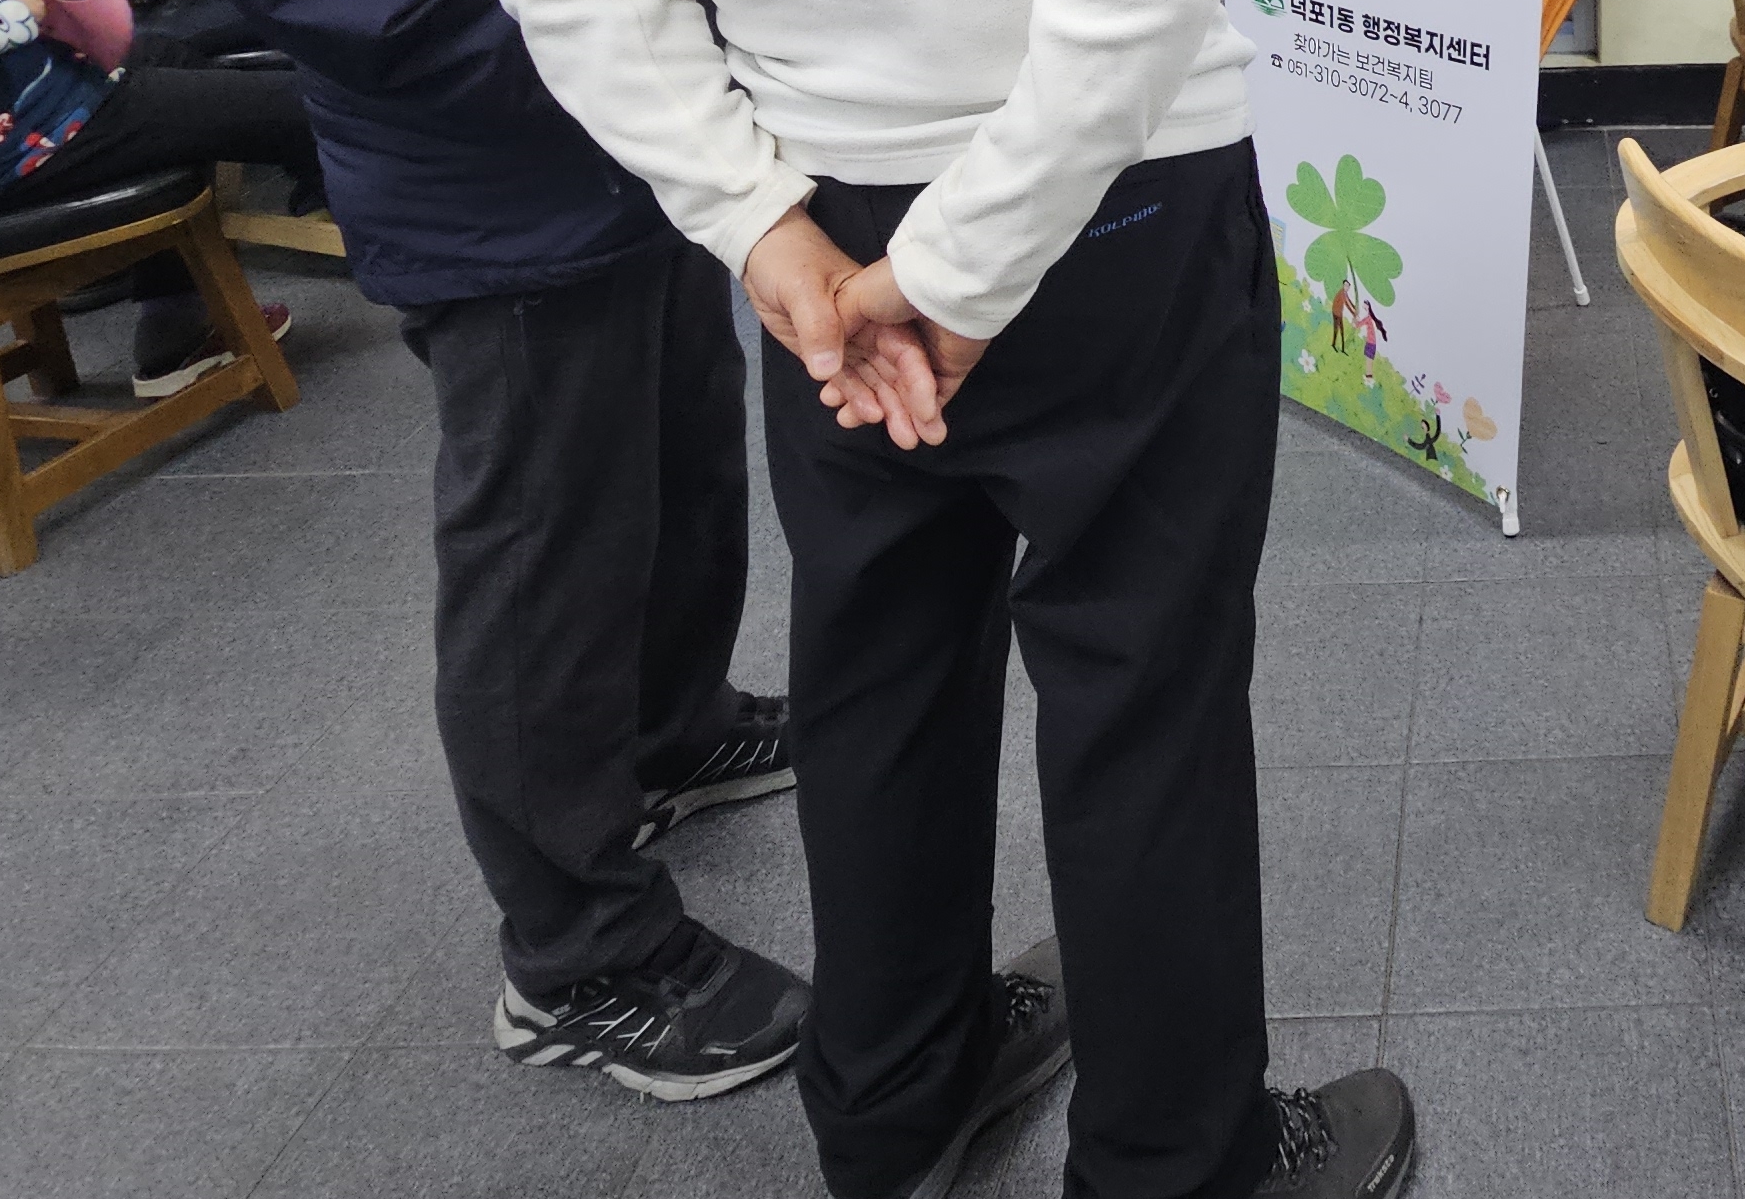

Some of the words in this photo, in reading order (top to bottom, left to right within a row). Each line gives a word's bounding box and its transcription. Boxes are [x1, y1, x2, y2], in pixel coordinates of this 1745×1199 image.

[1293, 32, 1351, 67] 찾아가는
[1355, 50, 1433, 91] 보건복지팀
[1361, 13, 1491, 71] 행정복지센터
[1287, 58, 1414, 113] 051-310-3072~4,
[1418, 95, 1463, 125] 3077
